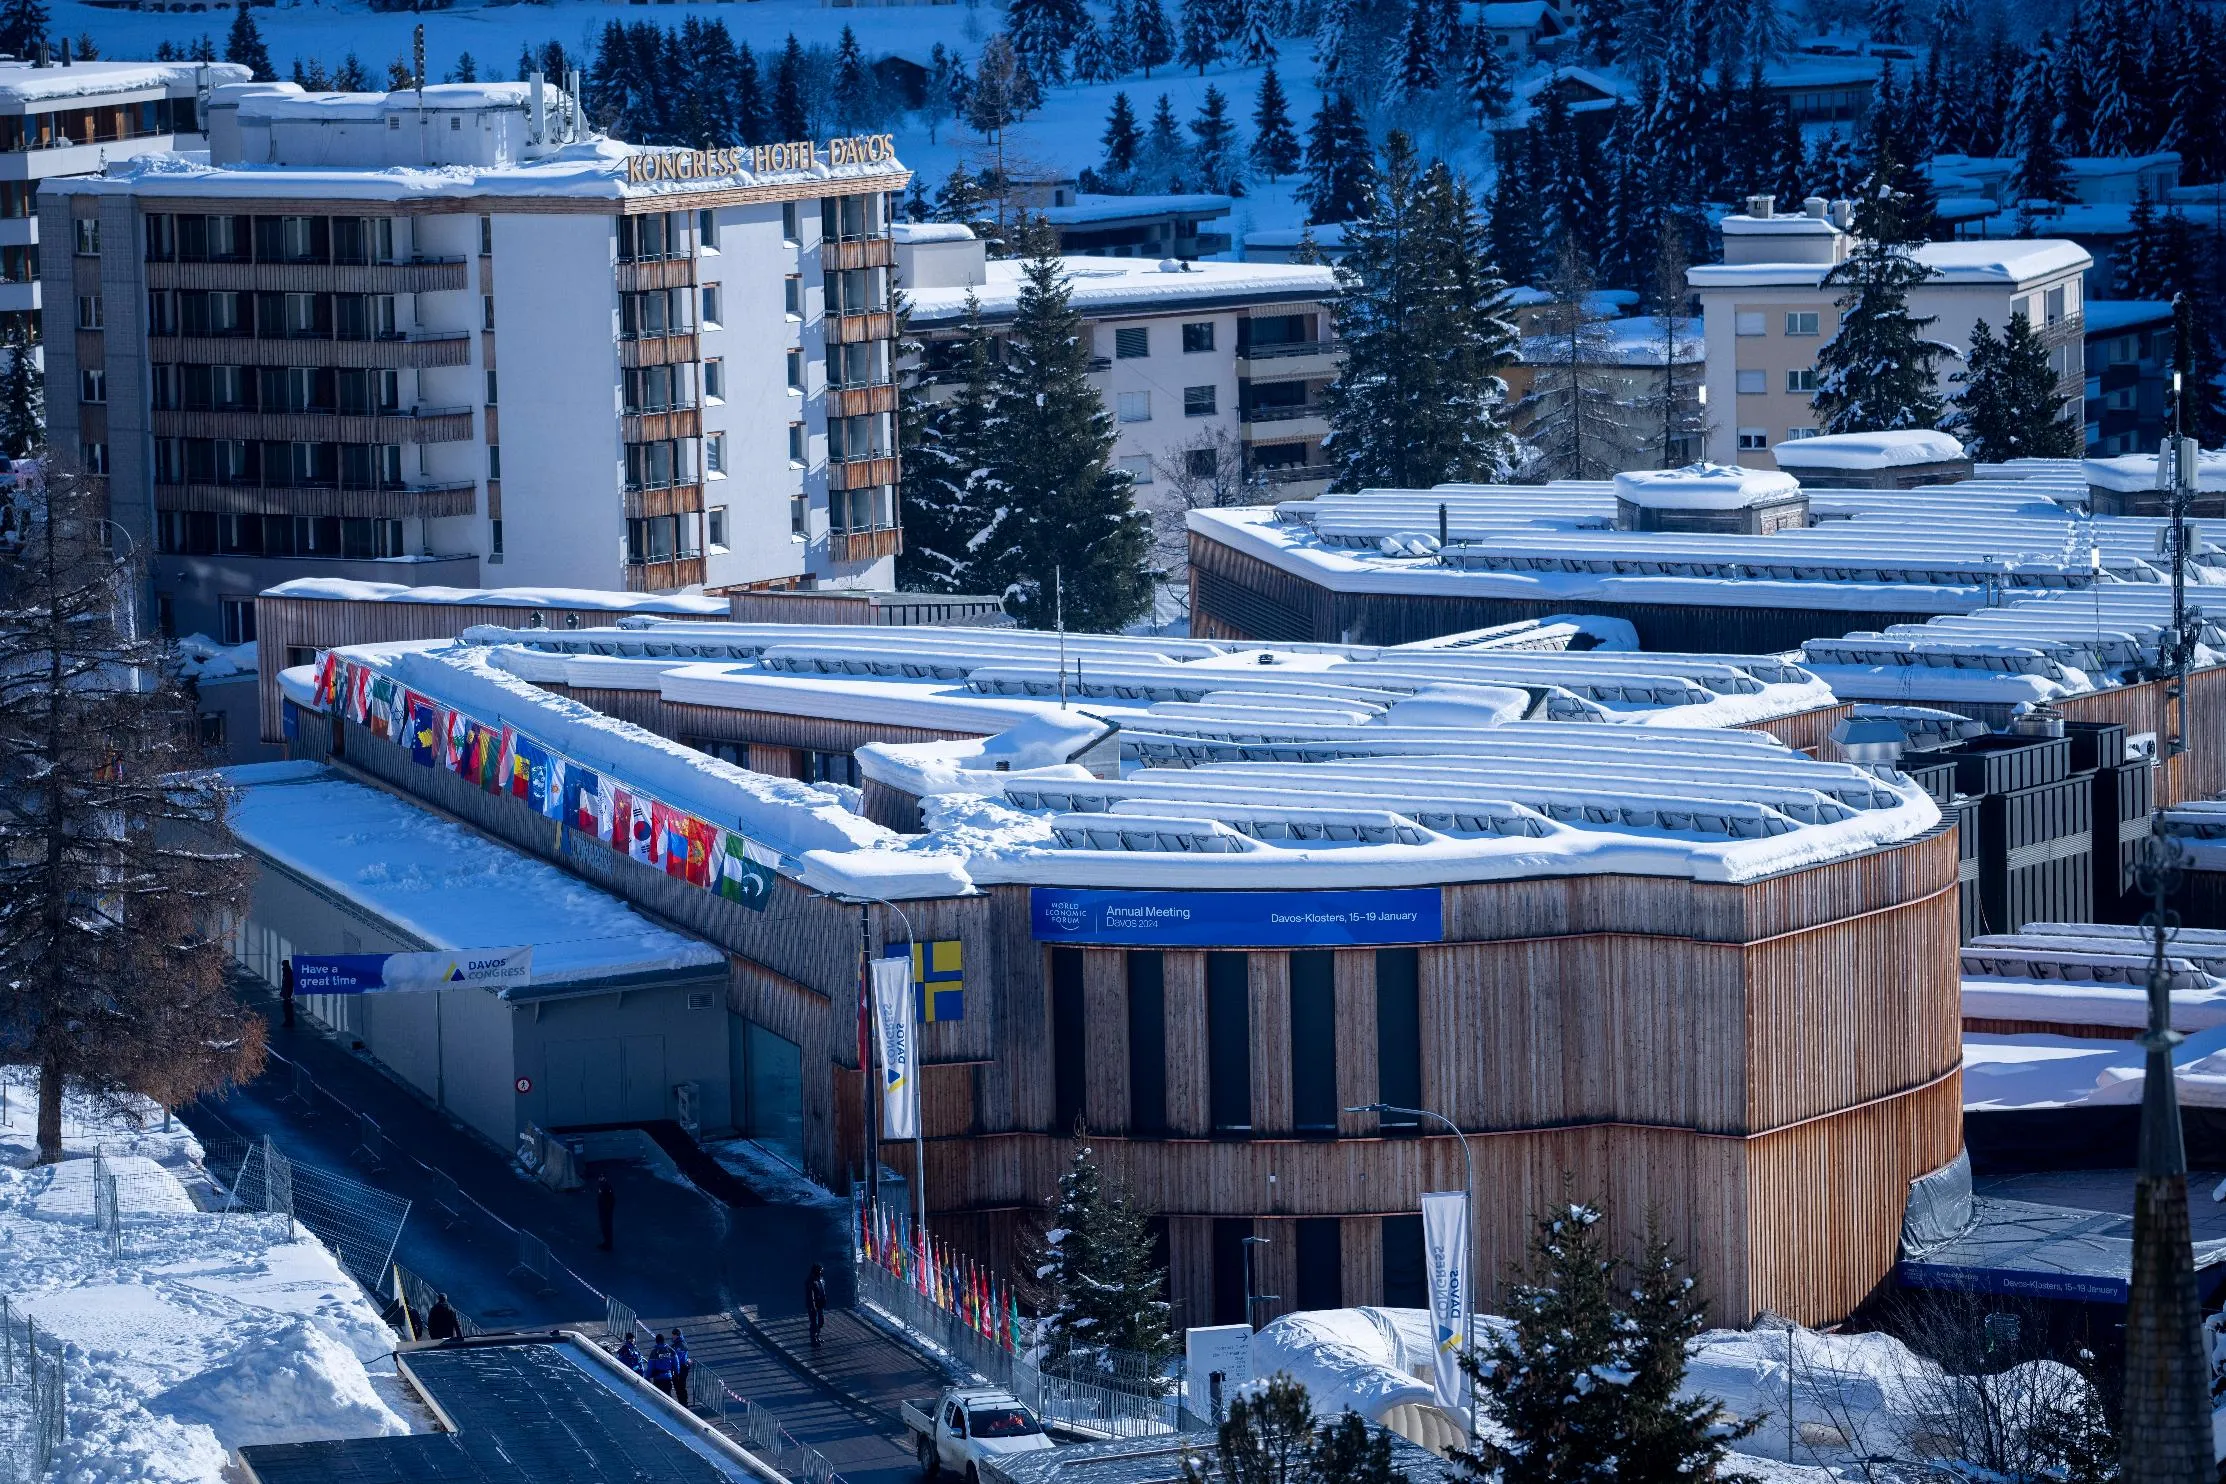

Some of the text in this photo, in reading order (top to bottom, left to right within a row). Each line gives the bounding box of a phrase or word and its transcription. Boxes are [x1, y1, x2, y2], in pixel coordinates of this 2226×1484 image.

[627, 133, 894, 182] KONGRESS HOTEL DAVOS
[1051, 902, 1079, 910] WORLD
[1106, 905, 1190, 919] Annual Meeting
[1045, 909, 1087, 917] ECONOMIC
[1271, 913, 1347, 924] Davos-Klosters,
[1378, 911, 1418, 922] January
[1051, 916, 1080, 924] FORUM
[1106, 917, 1159, 928] Davos 2024
[301, 964, 338, 975] Have a
[468, 958, 506, 971] DAVOS
[468, 966, 526, 980] CONGRESS
[300, 975, 357, 988] great time
